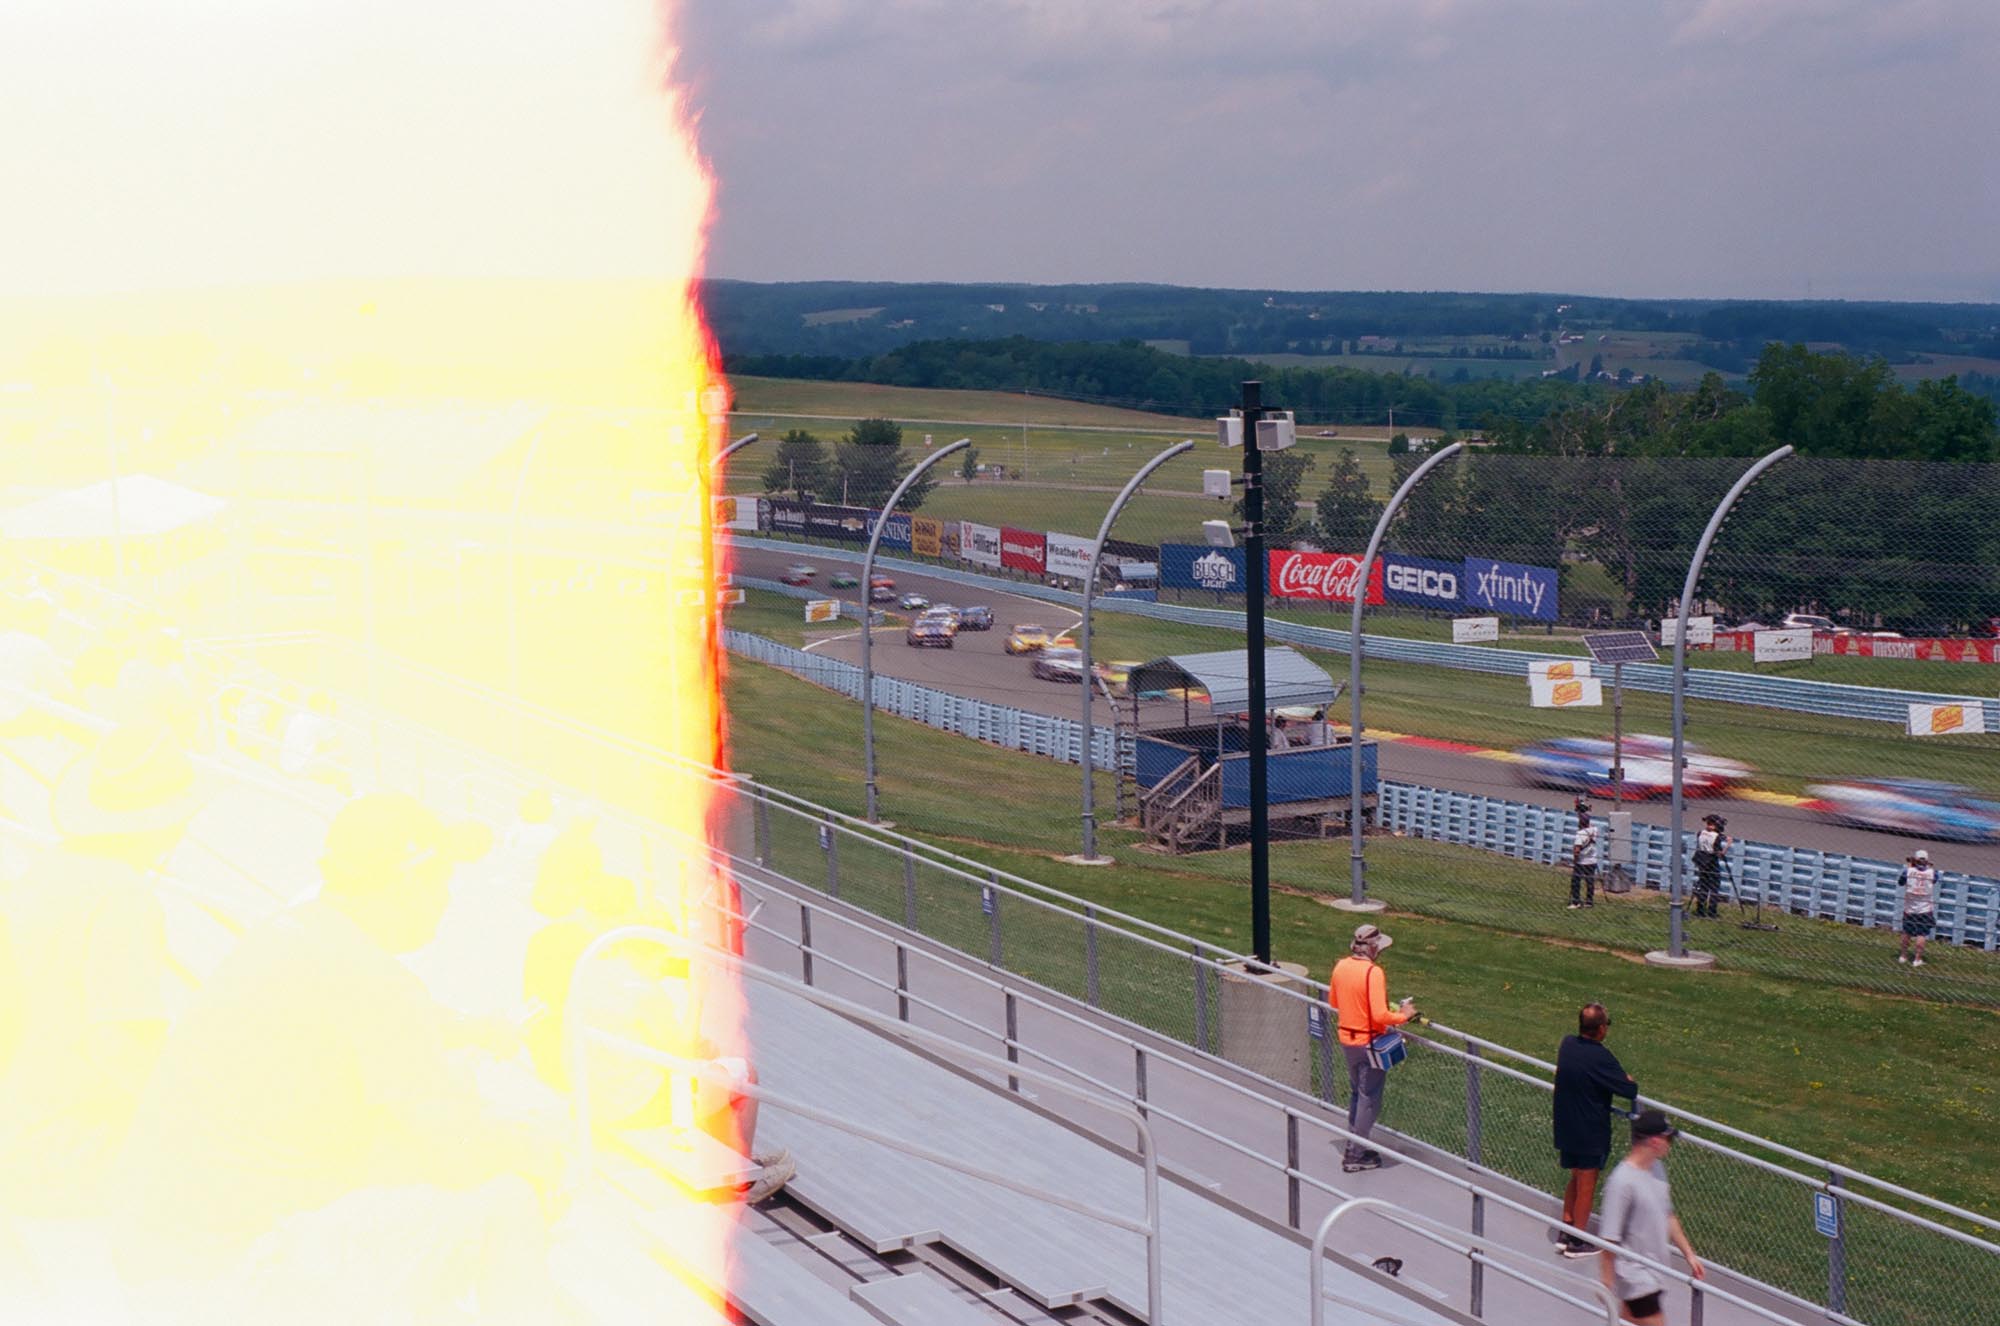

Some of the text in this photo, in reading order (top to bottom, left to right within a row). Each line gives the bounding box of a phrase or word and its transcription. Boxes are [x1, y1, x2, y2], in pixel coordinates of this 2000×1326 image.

[866, 519, 911, 542] CNING
[1048, 543, 1093, 561] WeatherTec
[1194, 562, 1235, 581] BUSCH
[1387, 564, 1457, 600] GEICO
[1477, 564, 1545, 614] xfinity
